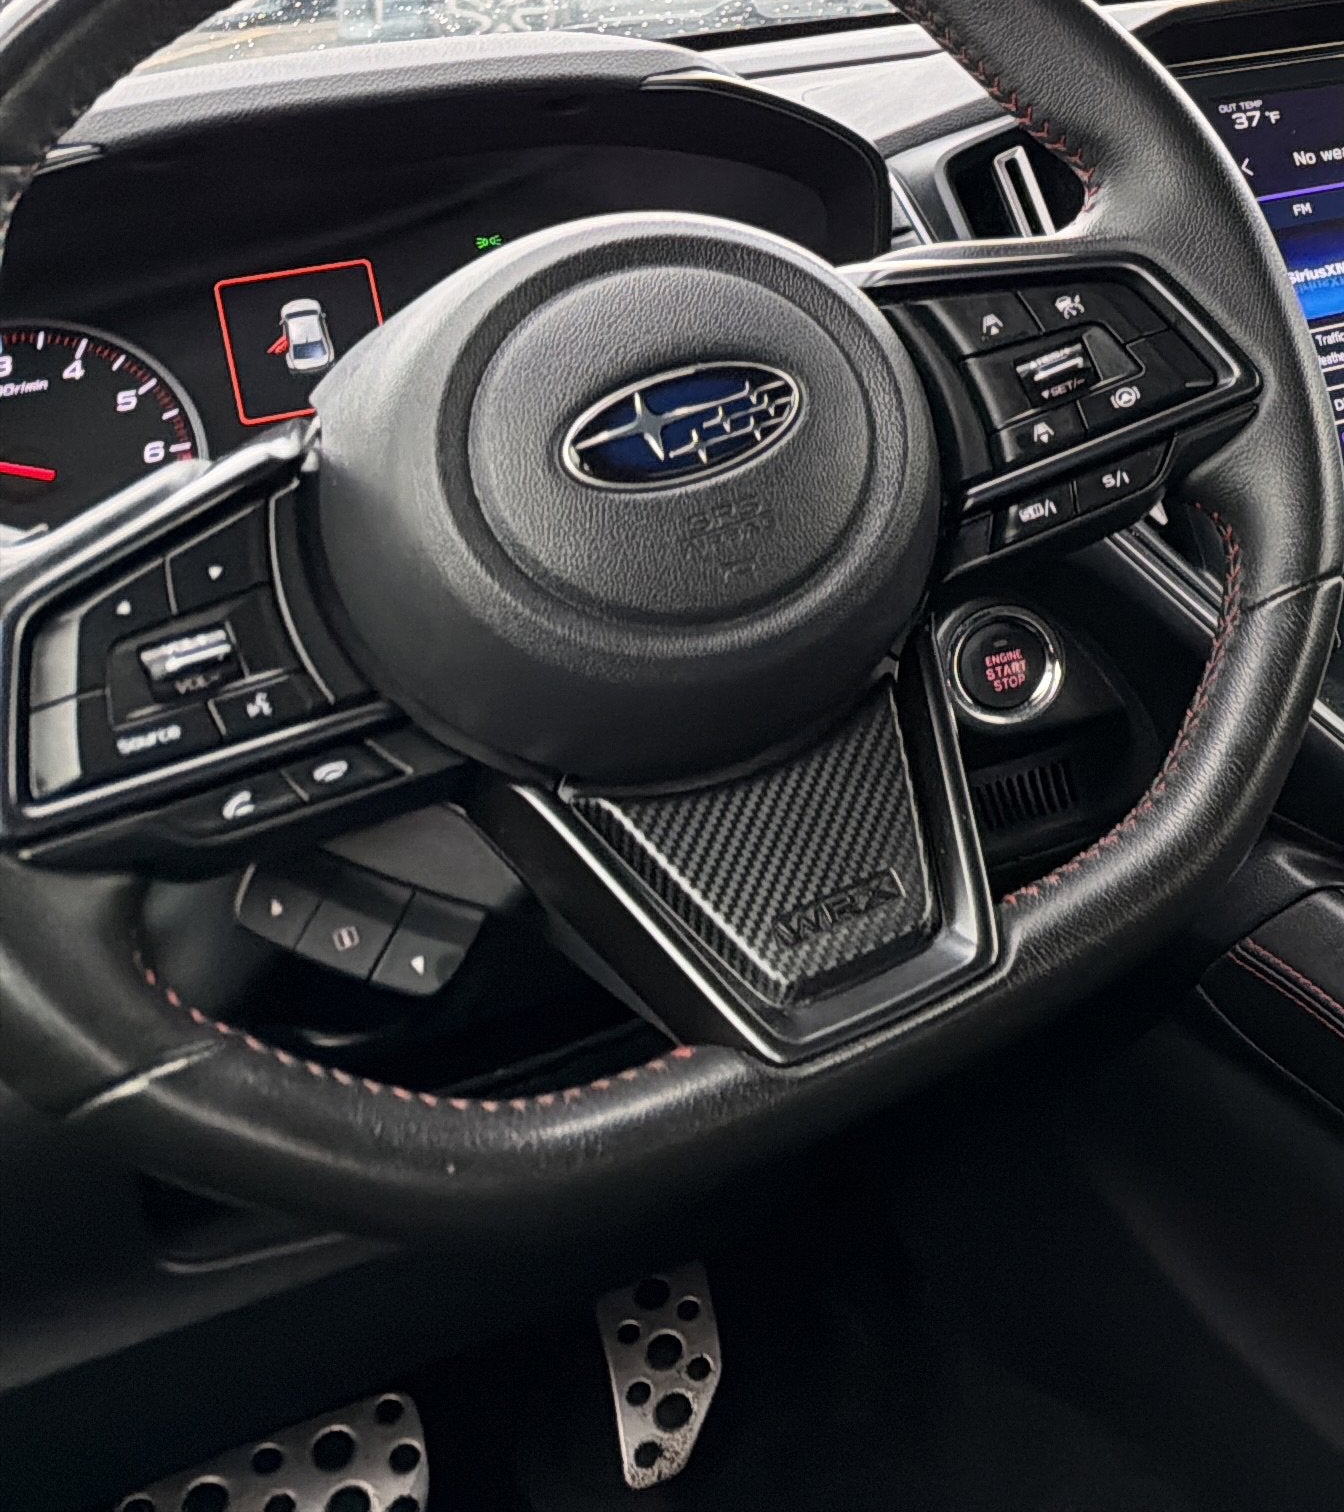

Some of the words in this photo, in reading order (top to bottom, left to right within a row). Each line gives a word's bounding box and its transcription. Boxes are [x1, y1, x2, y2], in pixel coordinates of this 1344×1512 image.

[1218, 102, 1237, 114] OUT
[1239, 100, 1263, 111] TEMP
[1231, 111, 1260, 130] 37
[1292, 149, 1316, 167] No
[1292, 202, 1312, 217] FM
[62, 360, 85, 380] 4
[116, 389, 138, 412] 5
[143, 440, 165, 464] 6
[985, 648, 1024, 667] ENGINE
[985, 659, 1026, 681] START
[993, 673, 1026, 693] STOP
